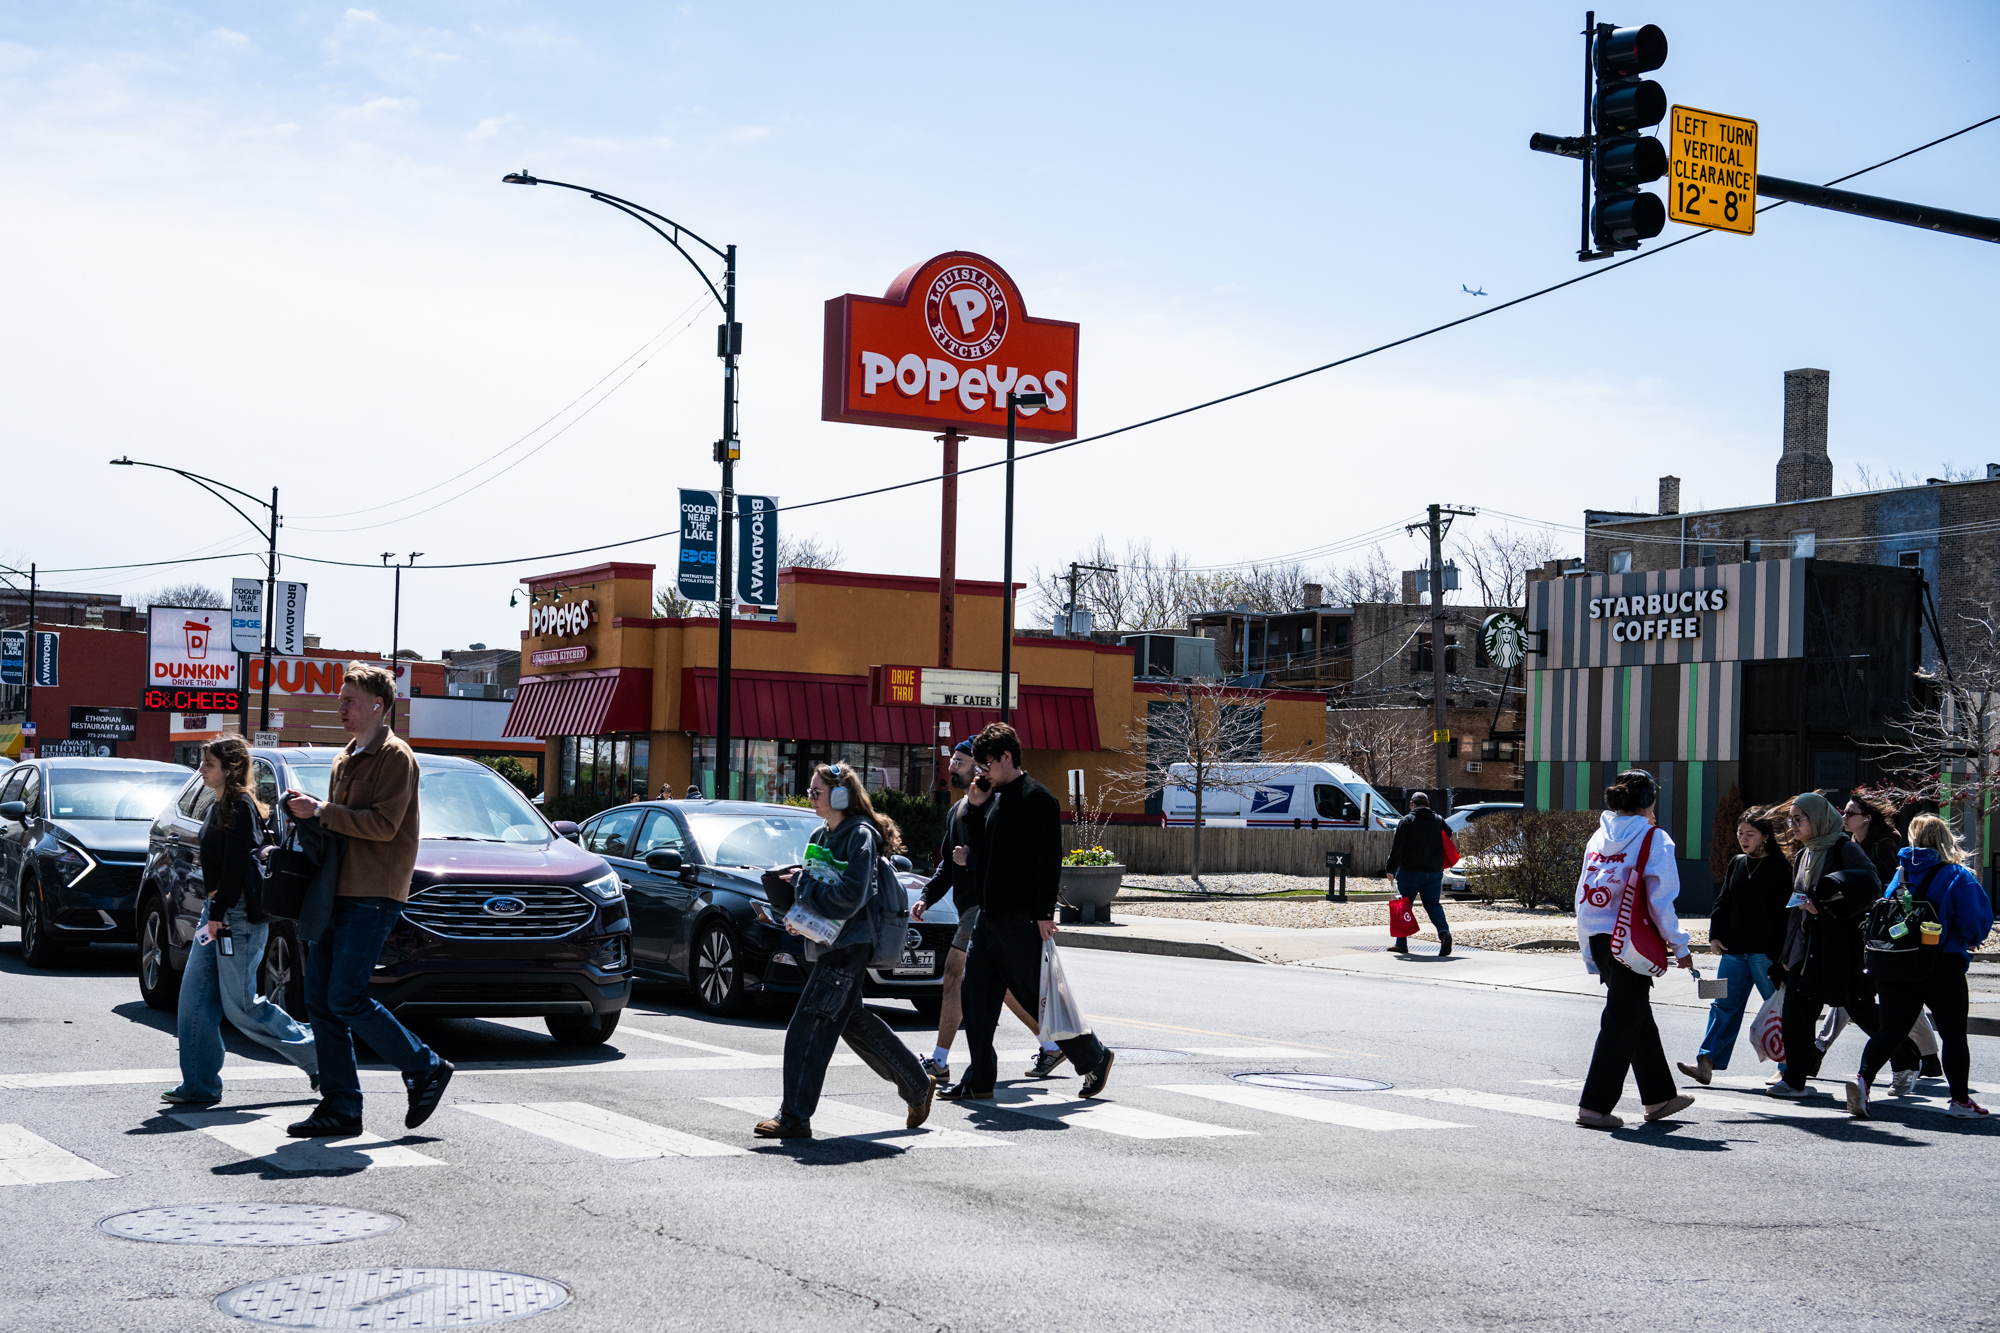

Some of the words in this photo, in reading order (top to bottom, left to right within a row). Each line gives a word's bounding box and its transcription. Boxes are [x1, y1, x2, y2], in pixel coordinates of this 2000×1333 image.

[1676, 114, 1708, 138] LEFT
[1719, 124, 1753, 147] TURN
[1683, 138, 1744, 167] VERTICAL
[1675, 159, 1750, 190] CLEARANCE
[929, 268, 1003, 311] LOUISIANA
[949, 288, 988, 335] P
[931, 322, 1002, 358] KITCHEN
[681, 503, 718, 516] COOLER
[687, 513, 711, 523] NEAR
[690, 521, 707, 531] THE
[684, 528, 714, 541] LAKE
[680, 548, 716, 564] EDGE
[751, 498, 765, 602] BROADWAY
[233, 587, 262, 596] COOLER
[235, 605, 259, 613] LAKE
[1589, 588, 1726, 619] STARBUCKS
[232, 618, 261, 629] EDGE
[285, 584, 298, 653] BROADWAY
[1612, 617, 1698, 643] COFFEE
[191, 635, 204, 649] D
[2, 659, 24, 667] EDGE
[42, 633, 52, 685] BROADWAY
[532, 651, 559, 664] LOUISIANA
[559, 649, 585, 661] KITCHEN
[154, 662, 236, 681] DUNKIN'
[891, 669, 915, 686] DRIVE
[171, 678, 195, 687] DRIVE
[196, 679, 218, 688] THRU
[892, 686, 914, 702] THRU
[944, 694, 958, 705] WE
[963, 695, 992, 707] CATER
[71, 722, 114, 731] RESTAURANT
[85, 715, 122, 724] ETHIOPIAN
[257, 740, 275, 748] LIMIT
[494, 900, 517, 911] Ford
[1595, 893, 1604, 904] 8
